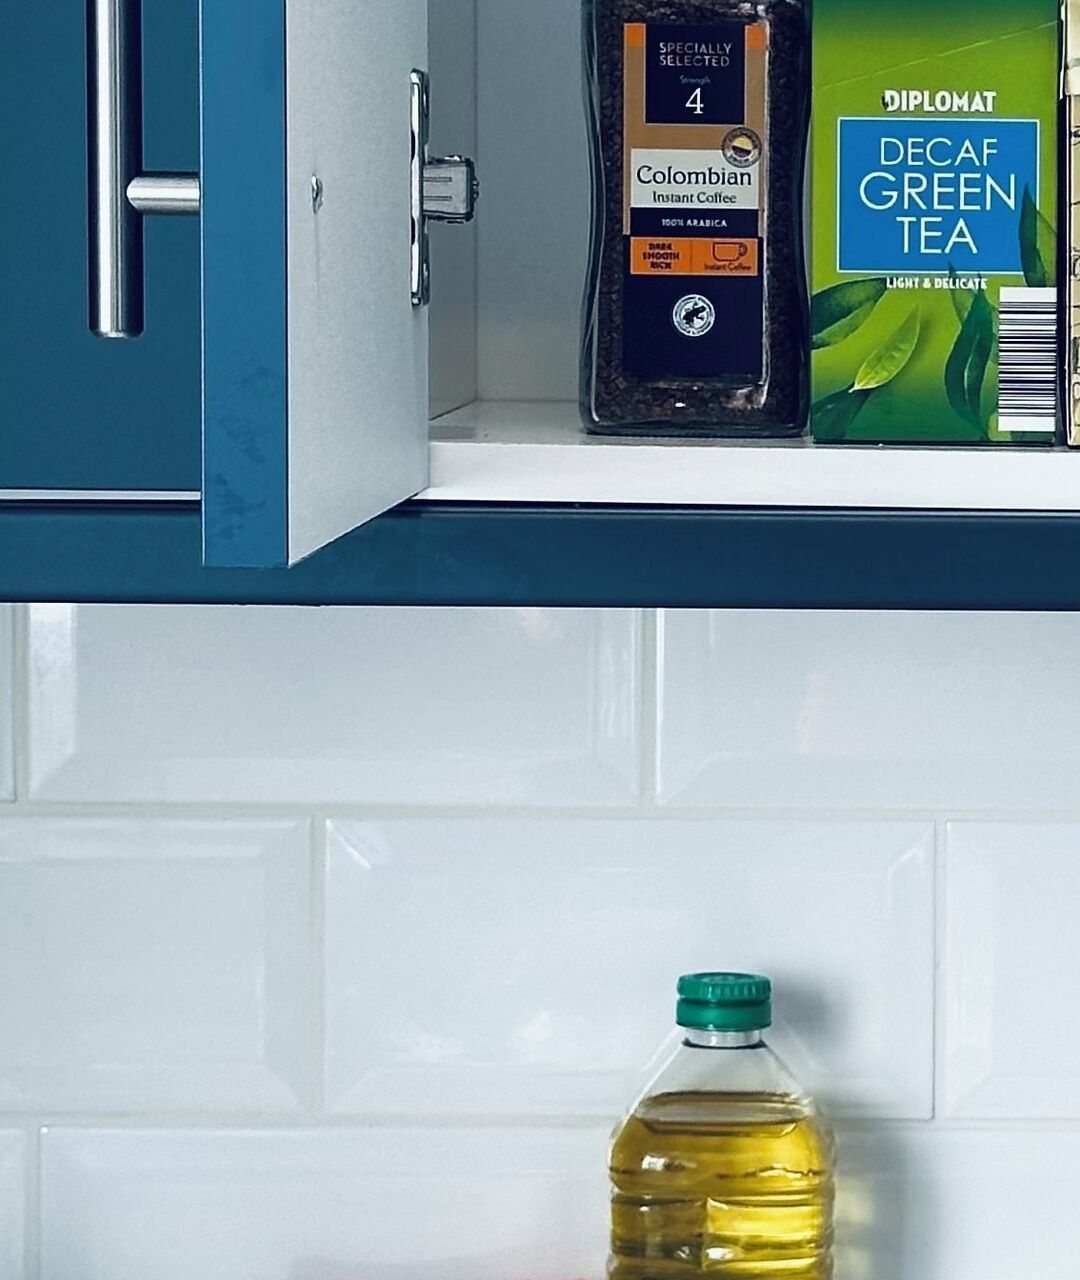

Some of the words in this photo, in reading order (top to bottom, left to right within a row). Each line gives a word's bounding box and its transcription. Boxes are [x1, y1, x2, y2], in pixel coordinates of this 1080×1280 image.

[659, 42, 732, 55] SPECIALLY
[659, 55, 730, 67] SELECTED
[685, 87, 704, 114] 4
[883, 90, 997, 113] DIPLOMAT
[880, 137, 998, 167] DECAF
[636, 165, 752, 186] Colombian
[652, 191, 694, 204] Instant
[697, 191, 737, 204] Coffee
[859, 171, 1015, 211] GREEN
[661, 218, 684, 227] 100%
[686, 219, 728, 228] ARABICA
[896, 216, 978, 254] TEA
[642, 252, 680, 261] SMOOTH
[886, 277, 920, 290] LIGHT
[934, 278, 988, 290] DELICATE
